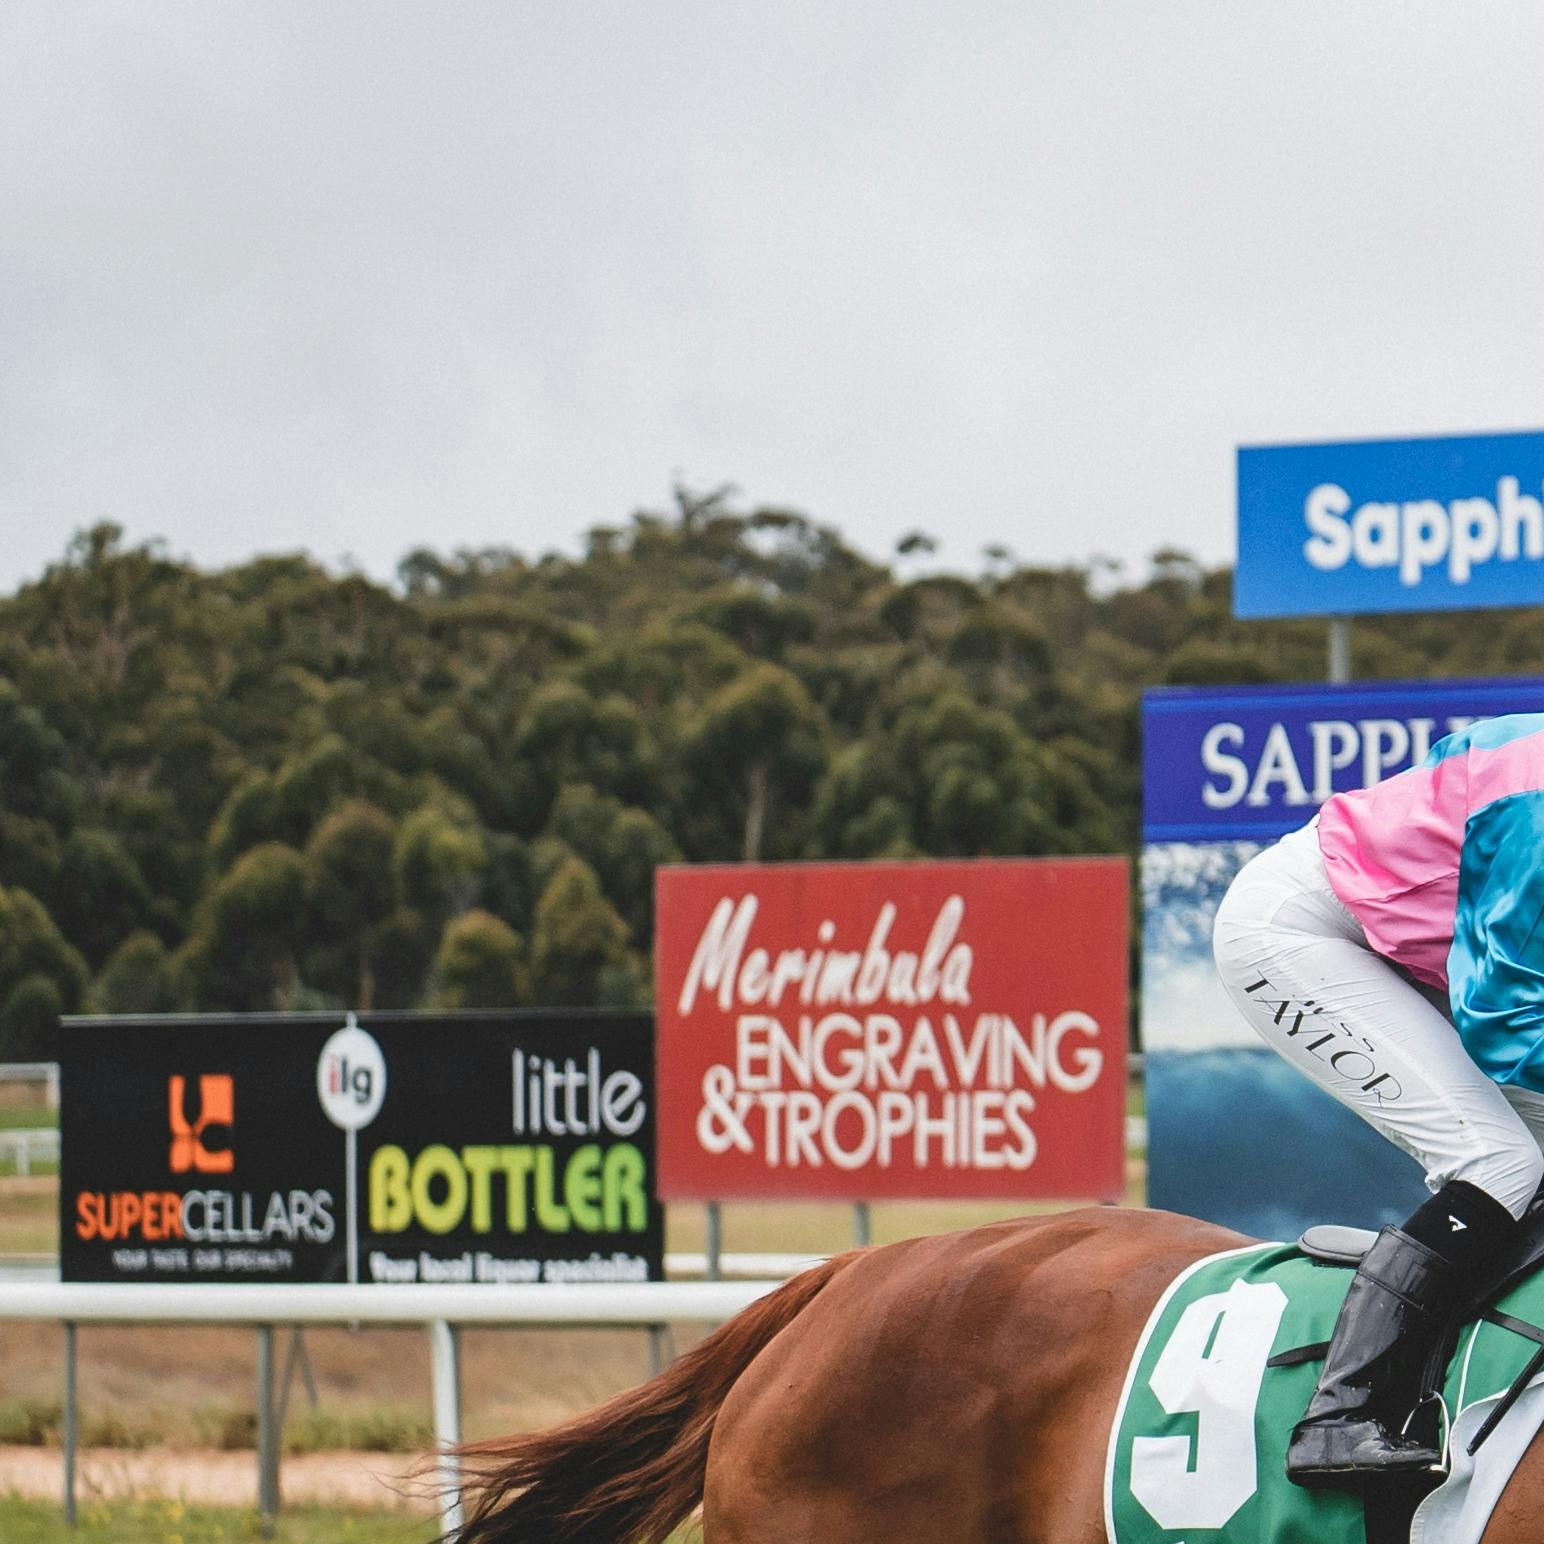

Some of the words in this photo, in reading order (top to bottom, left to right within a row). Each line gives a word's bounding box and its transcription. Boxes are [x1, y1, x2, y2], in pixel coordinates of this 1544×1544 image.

[677, 893, 973, 1016] Merimbula
[330, 1053, 372, 1104] ilg
[736, 1011, 1103, 1092] ENGRAVING
[1244, 969, 1402, 1108] TAYLOR
[512, 1047, 646, 1137] little
[75, 1190, 335, 1244] SUPERCELLARS
[369, 1143, 647, 1234] BOTTLER
[1129, 1278, 1288, 1529] 9
